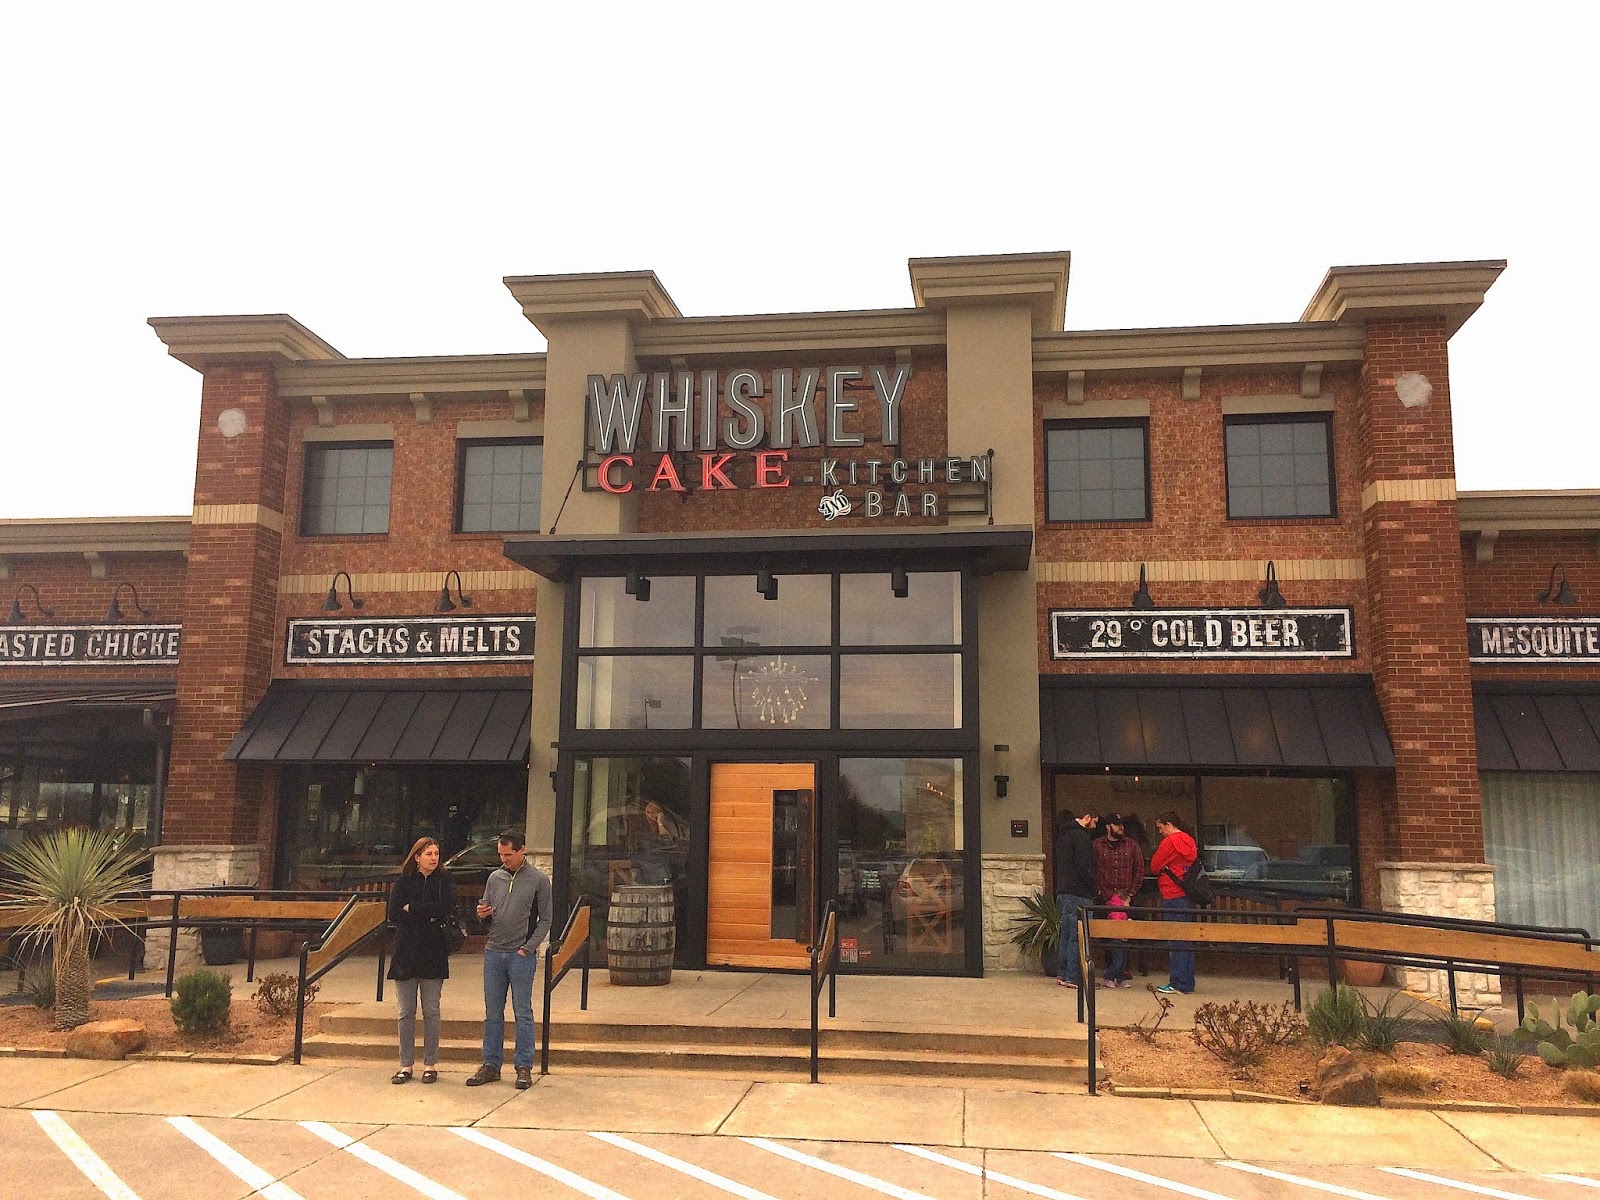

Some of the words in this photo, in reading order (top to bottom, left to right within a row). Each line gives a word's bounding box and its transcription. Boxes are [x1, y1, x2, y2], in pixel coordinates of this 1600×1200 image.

[587, 363, 912, 454] WHISKEY
[597, 450, 791, 494] CAKE
[820, 456, 988, 486] KITCHEN
[864, 488, 938, 517] BAR
[0, 633, 75, 658] ASTED
[86, 631, 180, 657] CHICKE
[307, 627, 410, 655] STACKS
[416, 631, 433, 653] &
[440, 625, 522, 652] MELTS
[1151, 618, 1223, 648] COLD
[1230, 618, 1301, 647] BEER
[1481, 625, 1600, 656] MESQUITE
